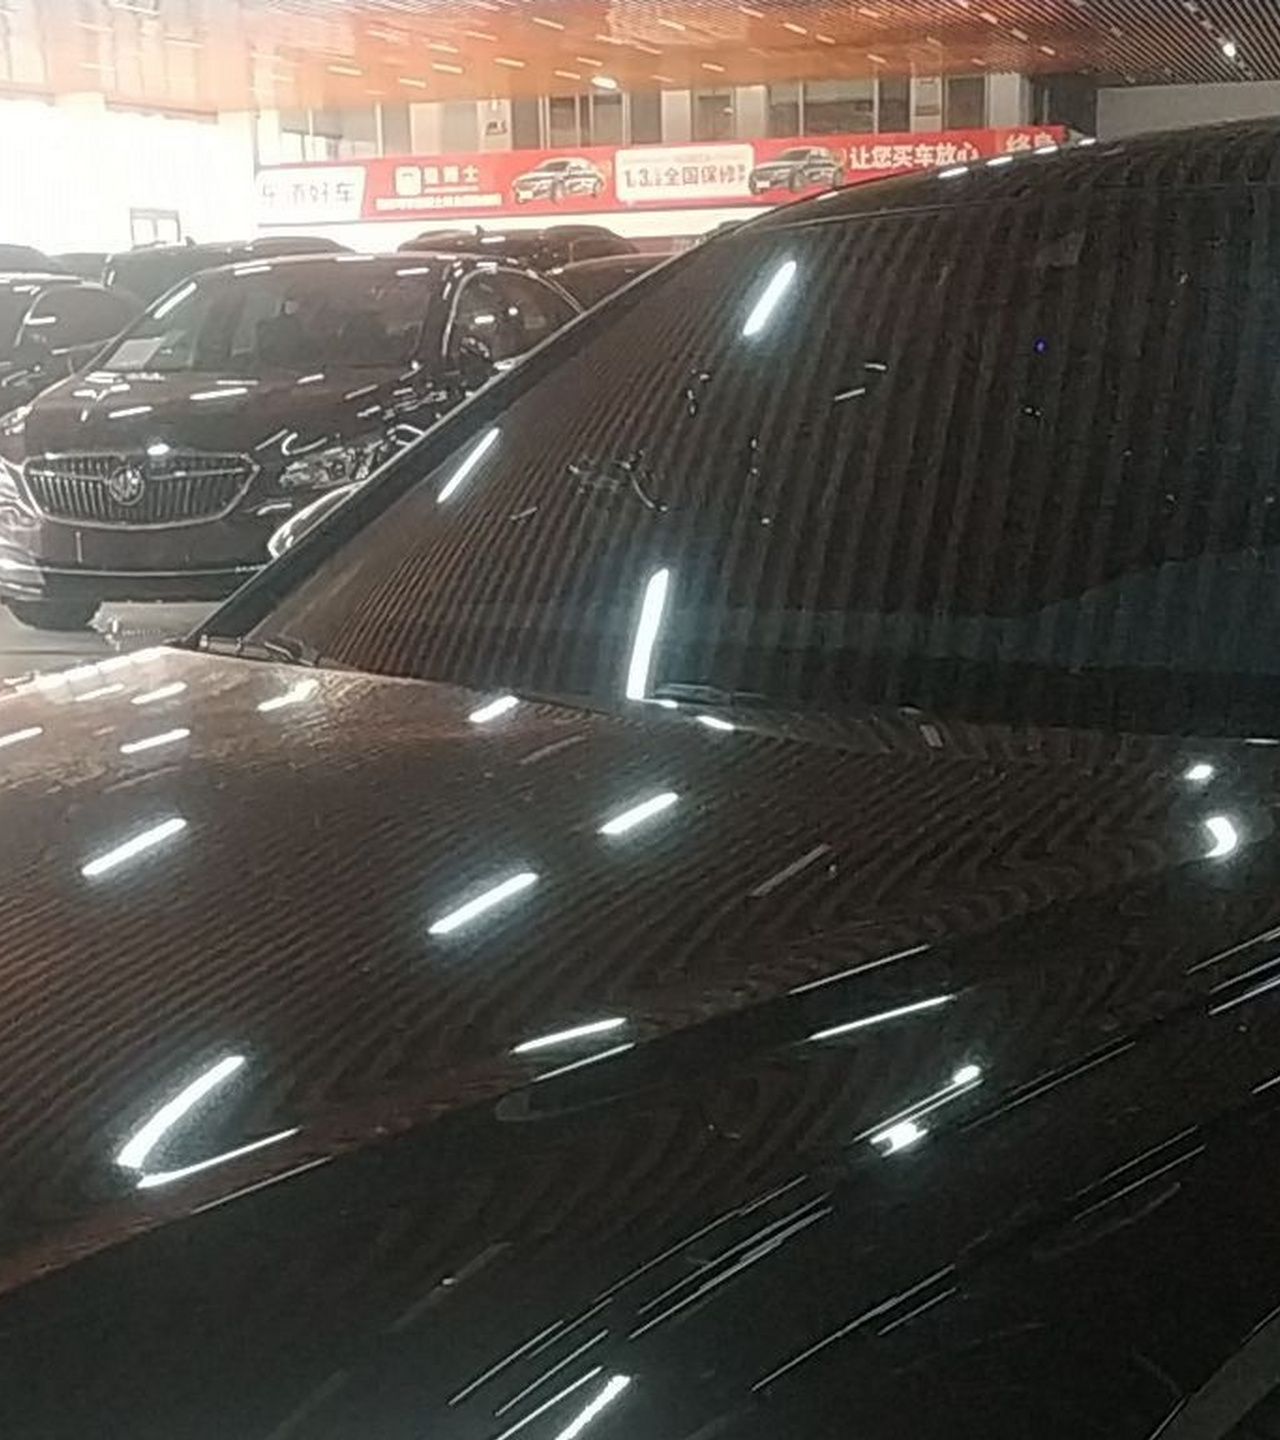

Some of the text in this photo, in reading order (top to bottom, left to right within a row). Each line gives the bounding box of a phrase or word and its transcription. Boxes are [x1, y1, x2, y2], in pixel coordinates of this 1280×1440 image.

[849, 140, 980, 170] 让您买车放心
